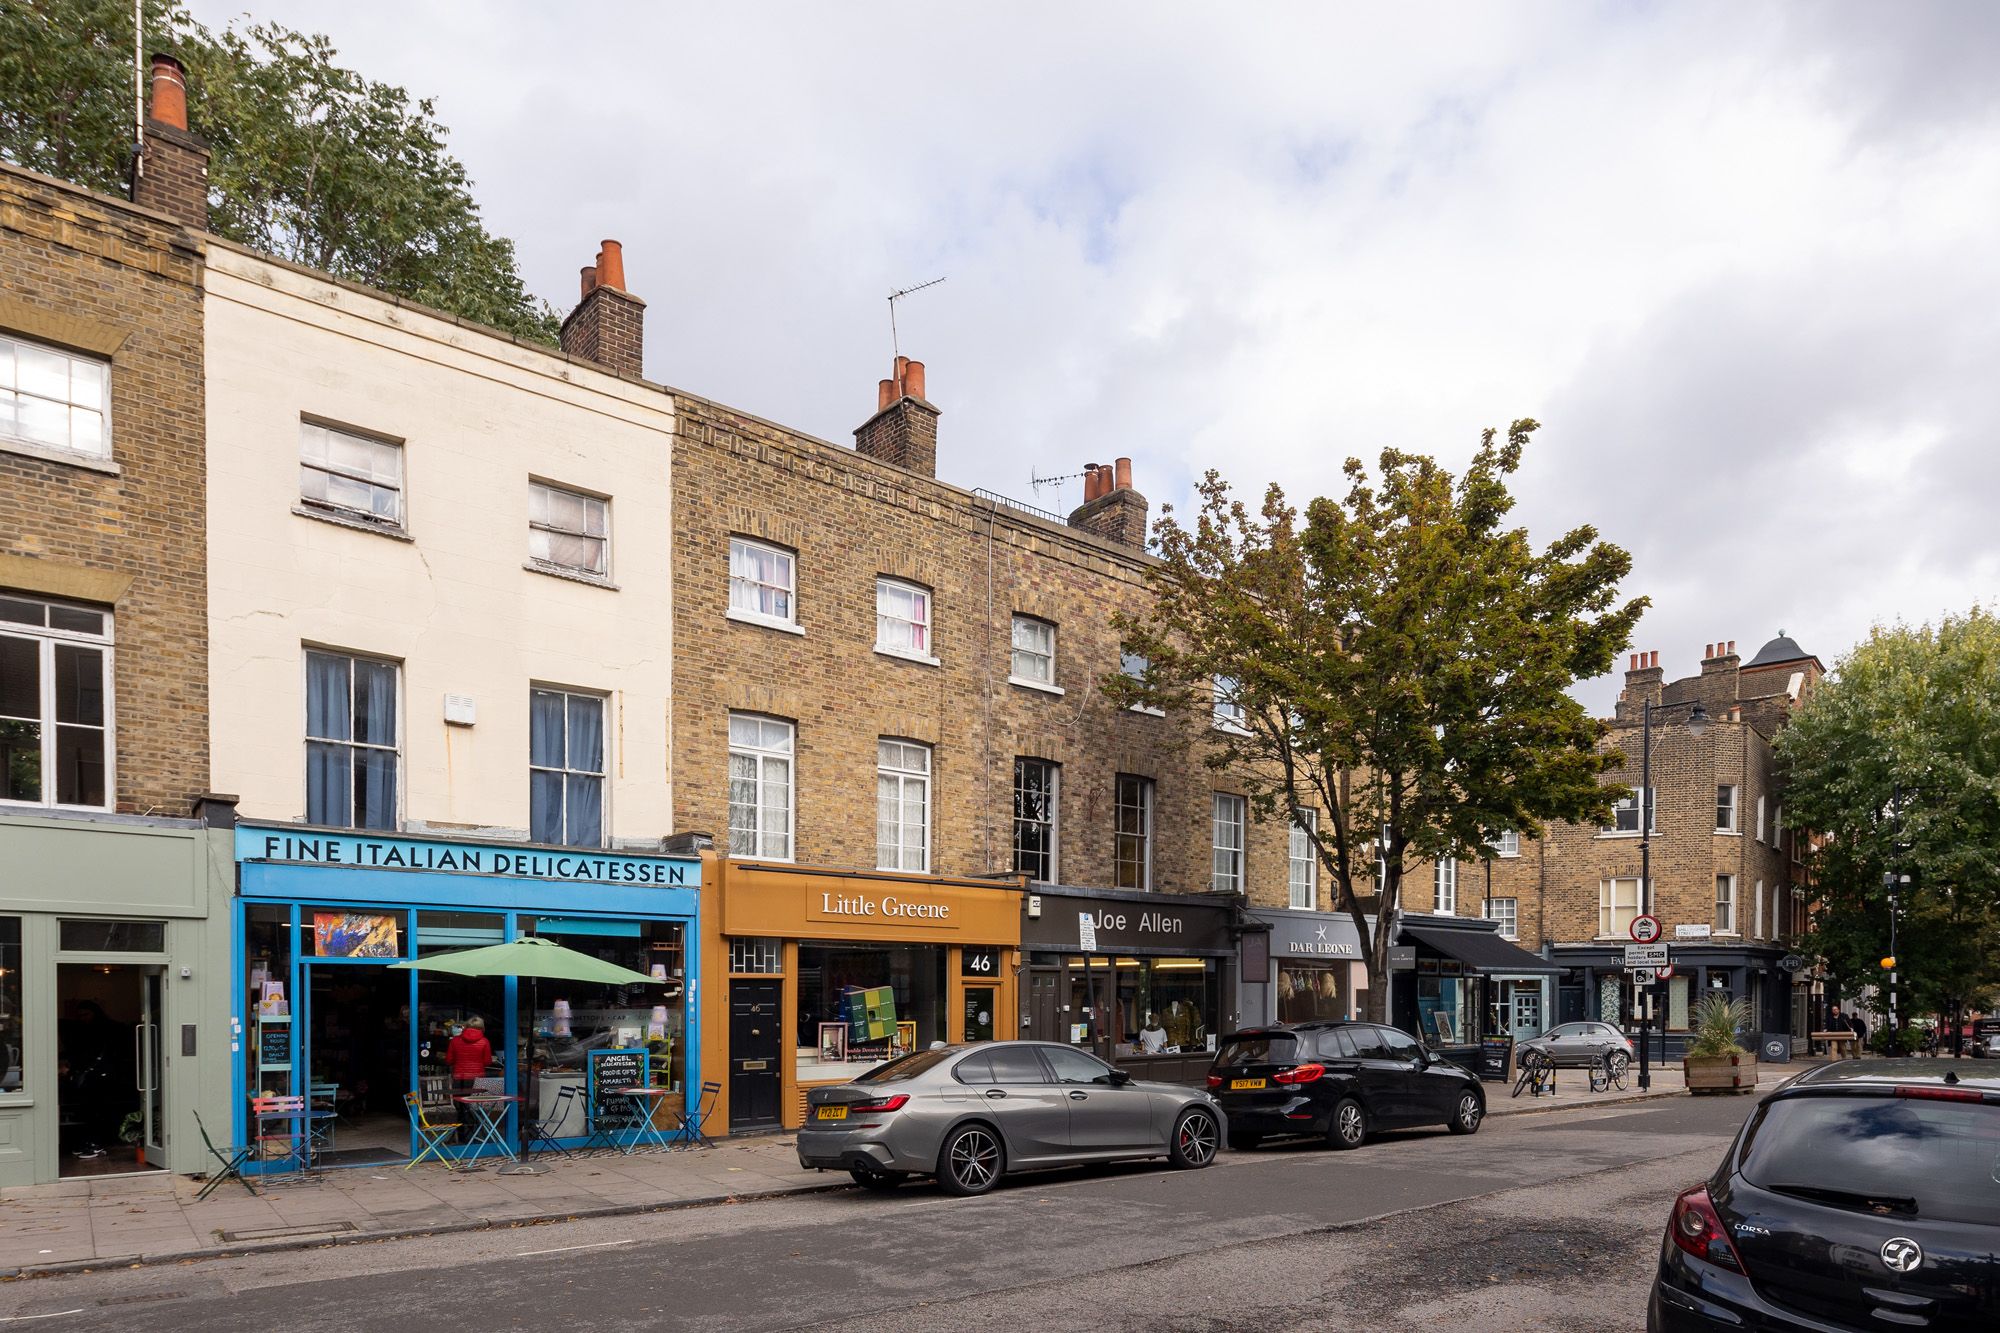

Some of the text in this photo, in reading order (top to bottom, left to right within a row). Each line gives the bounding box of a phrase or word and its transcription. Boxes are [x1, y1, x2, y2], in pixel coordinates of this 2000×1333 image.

[265, 836, 685, 884] FINE ITALIAN DELICATESSEN
[822, 892, 949, 918] Little Greene
[1094, 909, 1182, 934] Joe Allen
[1289, 942, 1353, 954] DAR LEONE
[970, 954, 990, 971] 46
[750, 1004, 760, 1013] 46
[1734, 1223, 1771, 1236] CORSA
